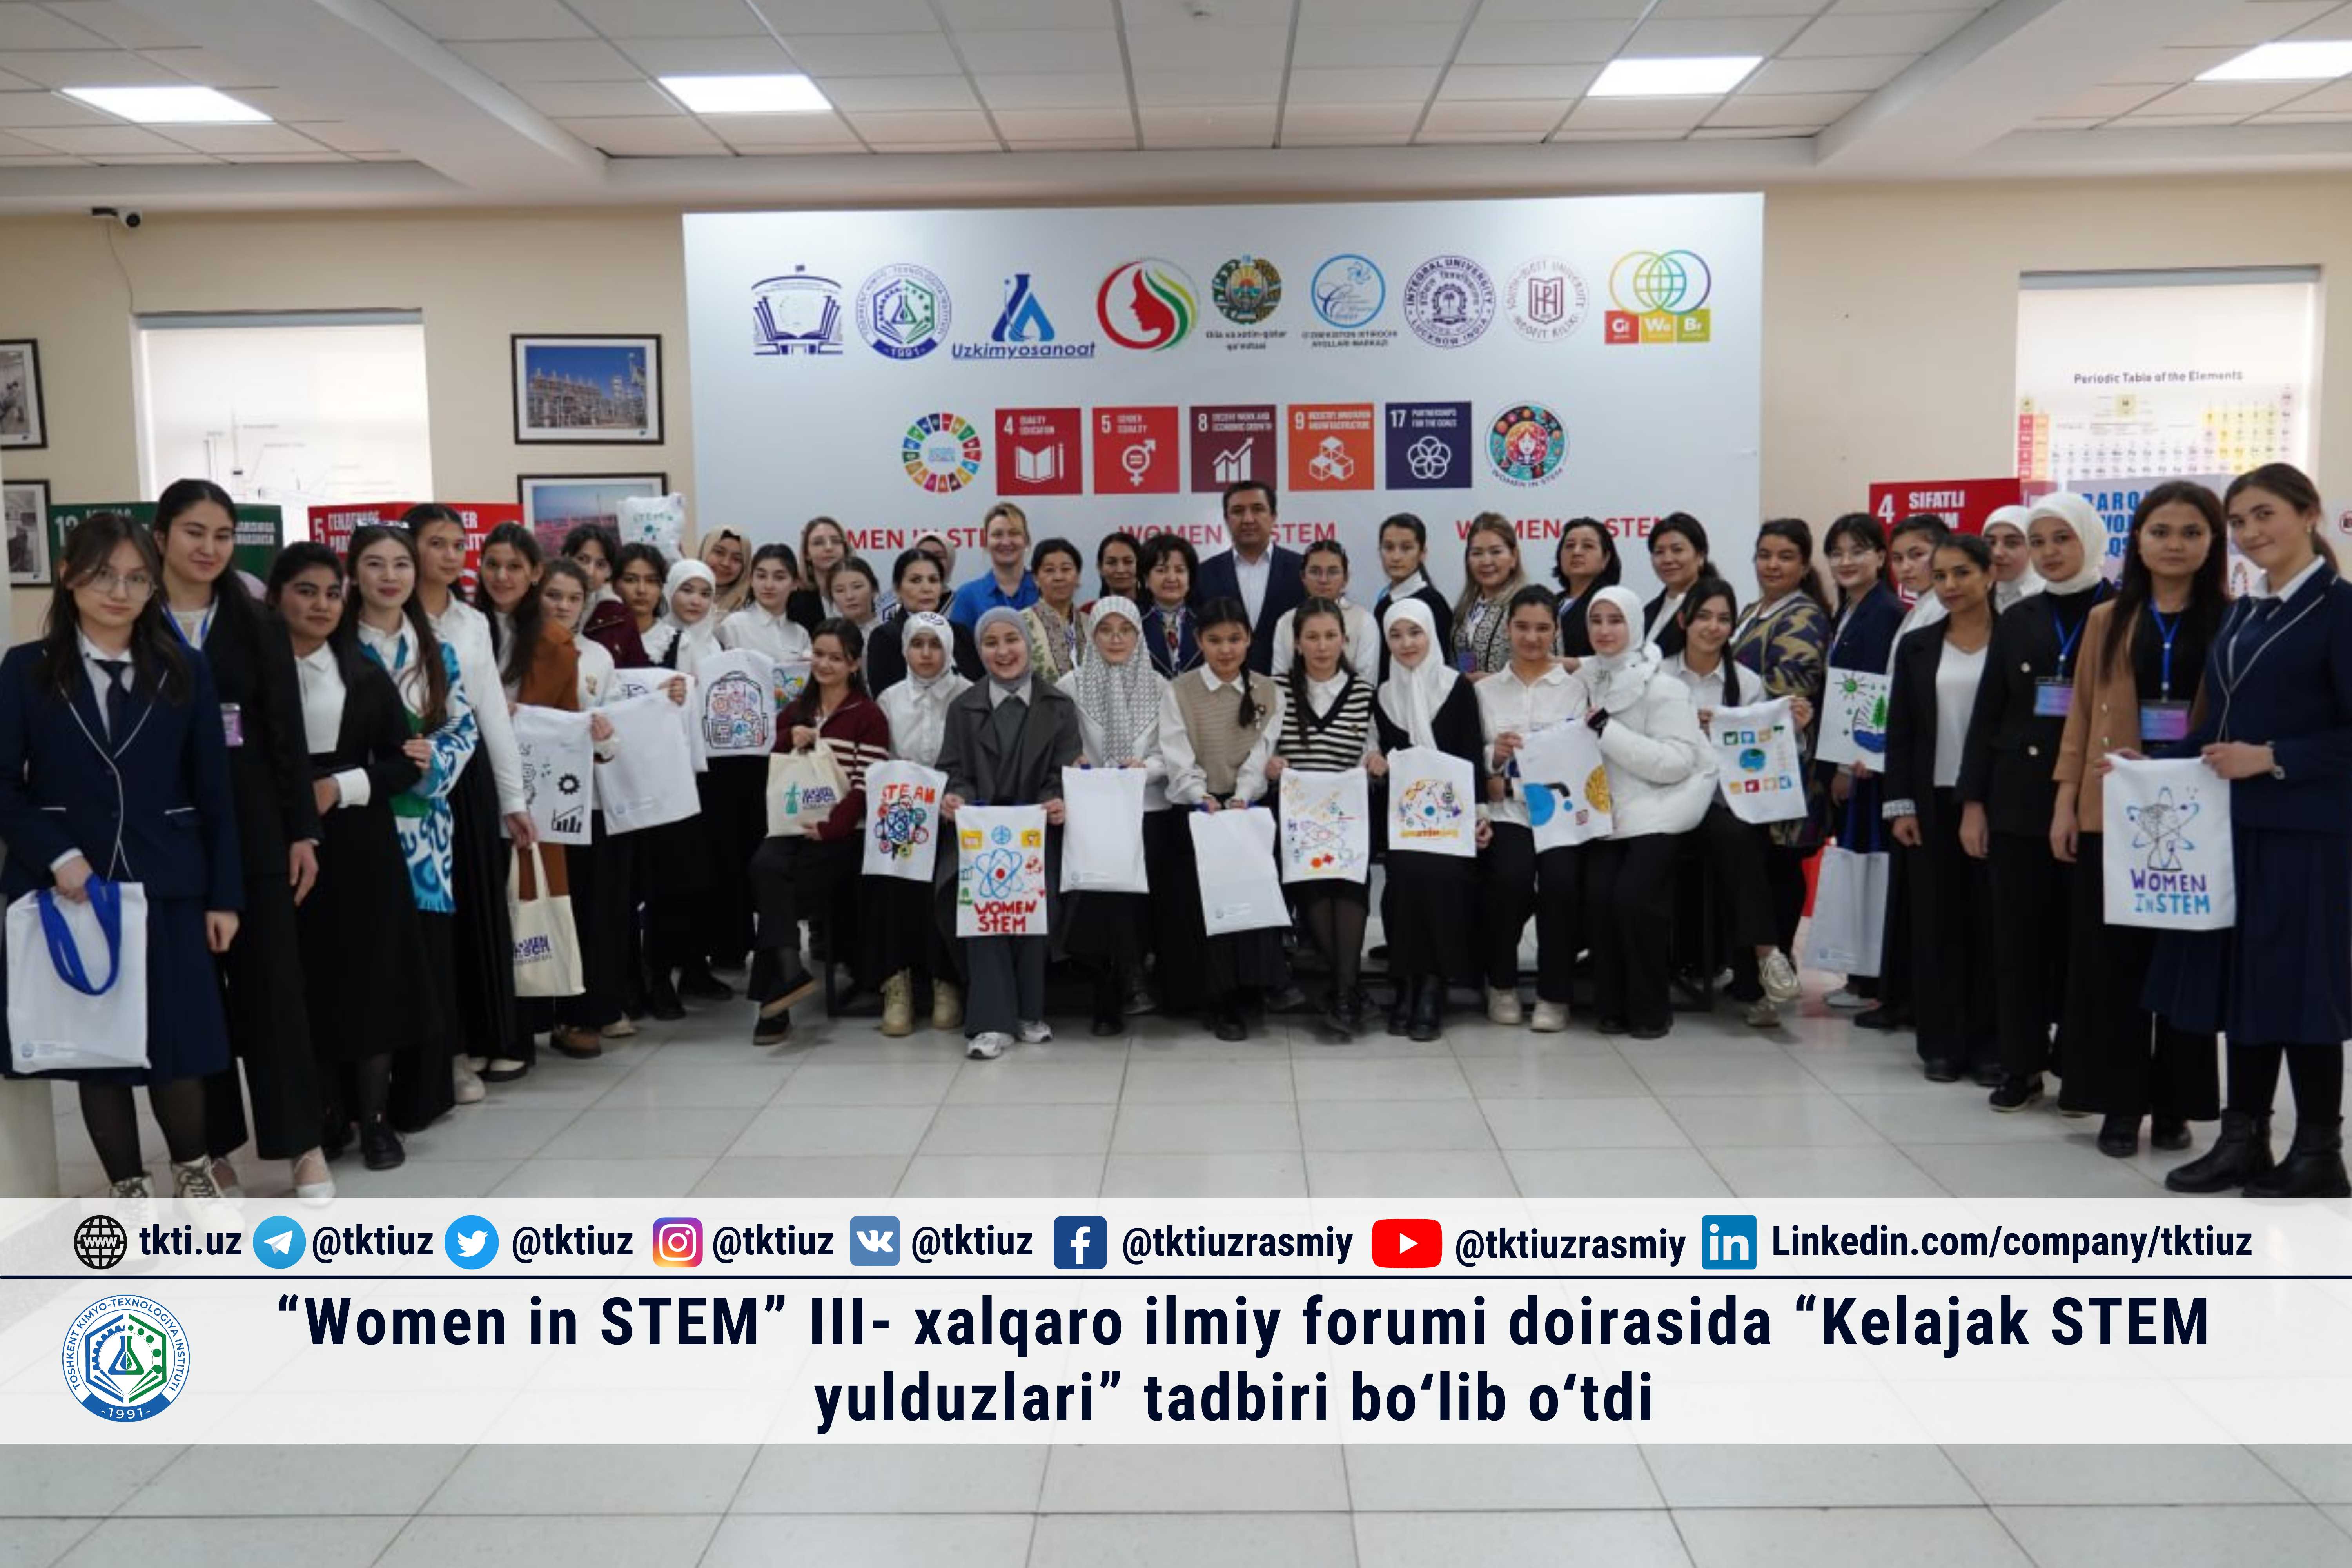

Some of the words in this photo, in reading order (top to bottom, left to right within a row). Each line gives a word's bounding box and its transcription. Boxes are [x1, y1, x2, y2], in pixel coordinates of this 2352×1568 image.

[1445, 259, 1491, 304] UNIVERSITY
[951, 342, 1095, 359] Uzkimyosanoat
[2074, 373, 2120, 384] Periodic
[2189, 370, 2243, 381] Elements
[1004, 416, 1014, 435] 4
[1101, 414, 1111, 434] 5
[1198, 413, 1208, 432] 8
[1390, 409, 1406, 428] 17
[1878, 494, 1895, 523] 4
[1909, 490, 1965, 509] SIFATLI
[315, 518, 325, 544] 5
[1604, 517, 1662, 539] STE
[2130, 868, 2207, 893] WOMEN
[973, 899, 1038, 915] WOMEN
[977, 915, 1026, 933] STEM
